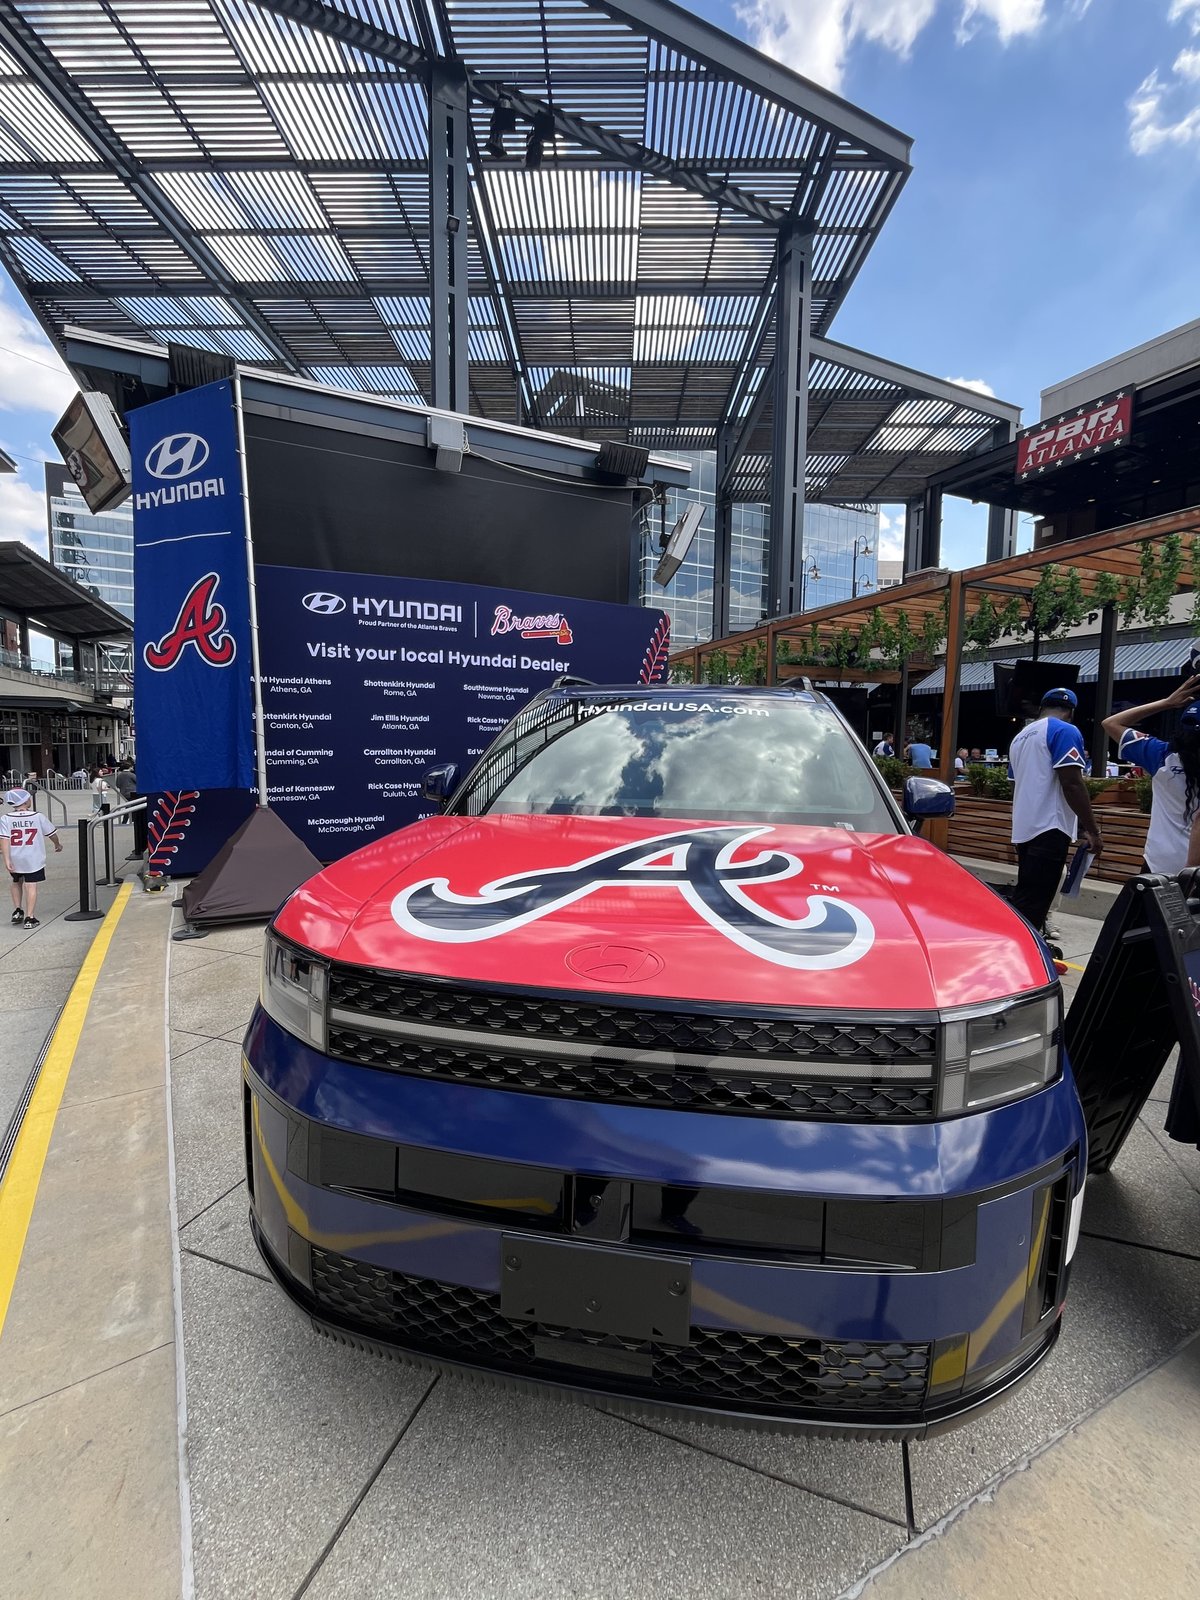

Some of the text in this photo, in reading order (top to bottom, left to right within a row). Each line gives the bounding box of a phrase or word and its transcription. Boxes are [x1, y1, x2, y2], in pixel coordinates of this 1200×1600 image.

[1027, 404, 1119, 453] PBR
[1022, 419, 1124, 469] ATLANTA
[135, 477, 225, 510] HYUNDAI
[352, 597, 463, 622] HYUNDAI
[490, 605, 561, 636] Braves
[358, 619, 377, 627] Proud
[377, 620, 399, 628] Partner
[417, 623, 438, 631] Atlanta
[438, 625, 458, 633] Braves
[306, 642, 570, 672] Visit your local Hyundai Dealer
[250, 676, 332, 685] AM Hyundai Athens
[363, 680, 436, 690] Shottenkirk Hyundai
[270, 686, 299, 694] Athens,
[383, 689, 406, 697] Rome,
[463, 684, 529, 694] Southtowne Hyundai
[478, 693, 505, 701] Newnan,
[578, 701, 770, 717] HyundaiUSA.com
[252, 713, 332, 722] Sottenkirk Hyundai
[400, 715, 430, 723] Hyundai
[270, 722, 301, 730] Canton,
[381, 723, 409, 731] Atlanta,
[295, 749, 334, 758] Cumming
[363, 748, 437, 757] Carrollton Hyundai
[266, 758, 307, 766] Cumming,
[374, 758, 413, 766] Carrollton,
[250, 785, 284, 795] Hyndai
[295, 784, 335, 793] Kennesaw
[403, 782, 422, 791] Hyun
[266, 793, 320, 802] Kennesaw, GA
[382, 790, 407, 798] Duluth,
[307, 815, 385, 826] McDonough Hyundai
[318, 825, 364, 834] McDonough,
[10, 828, 38, 846] 27
[810, 883, 840, 892] TM
